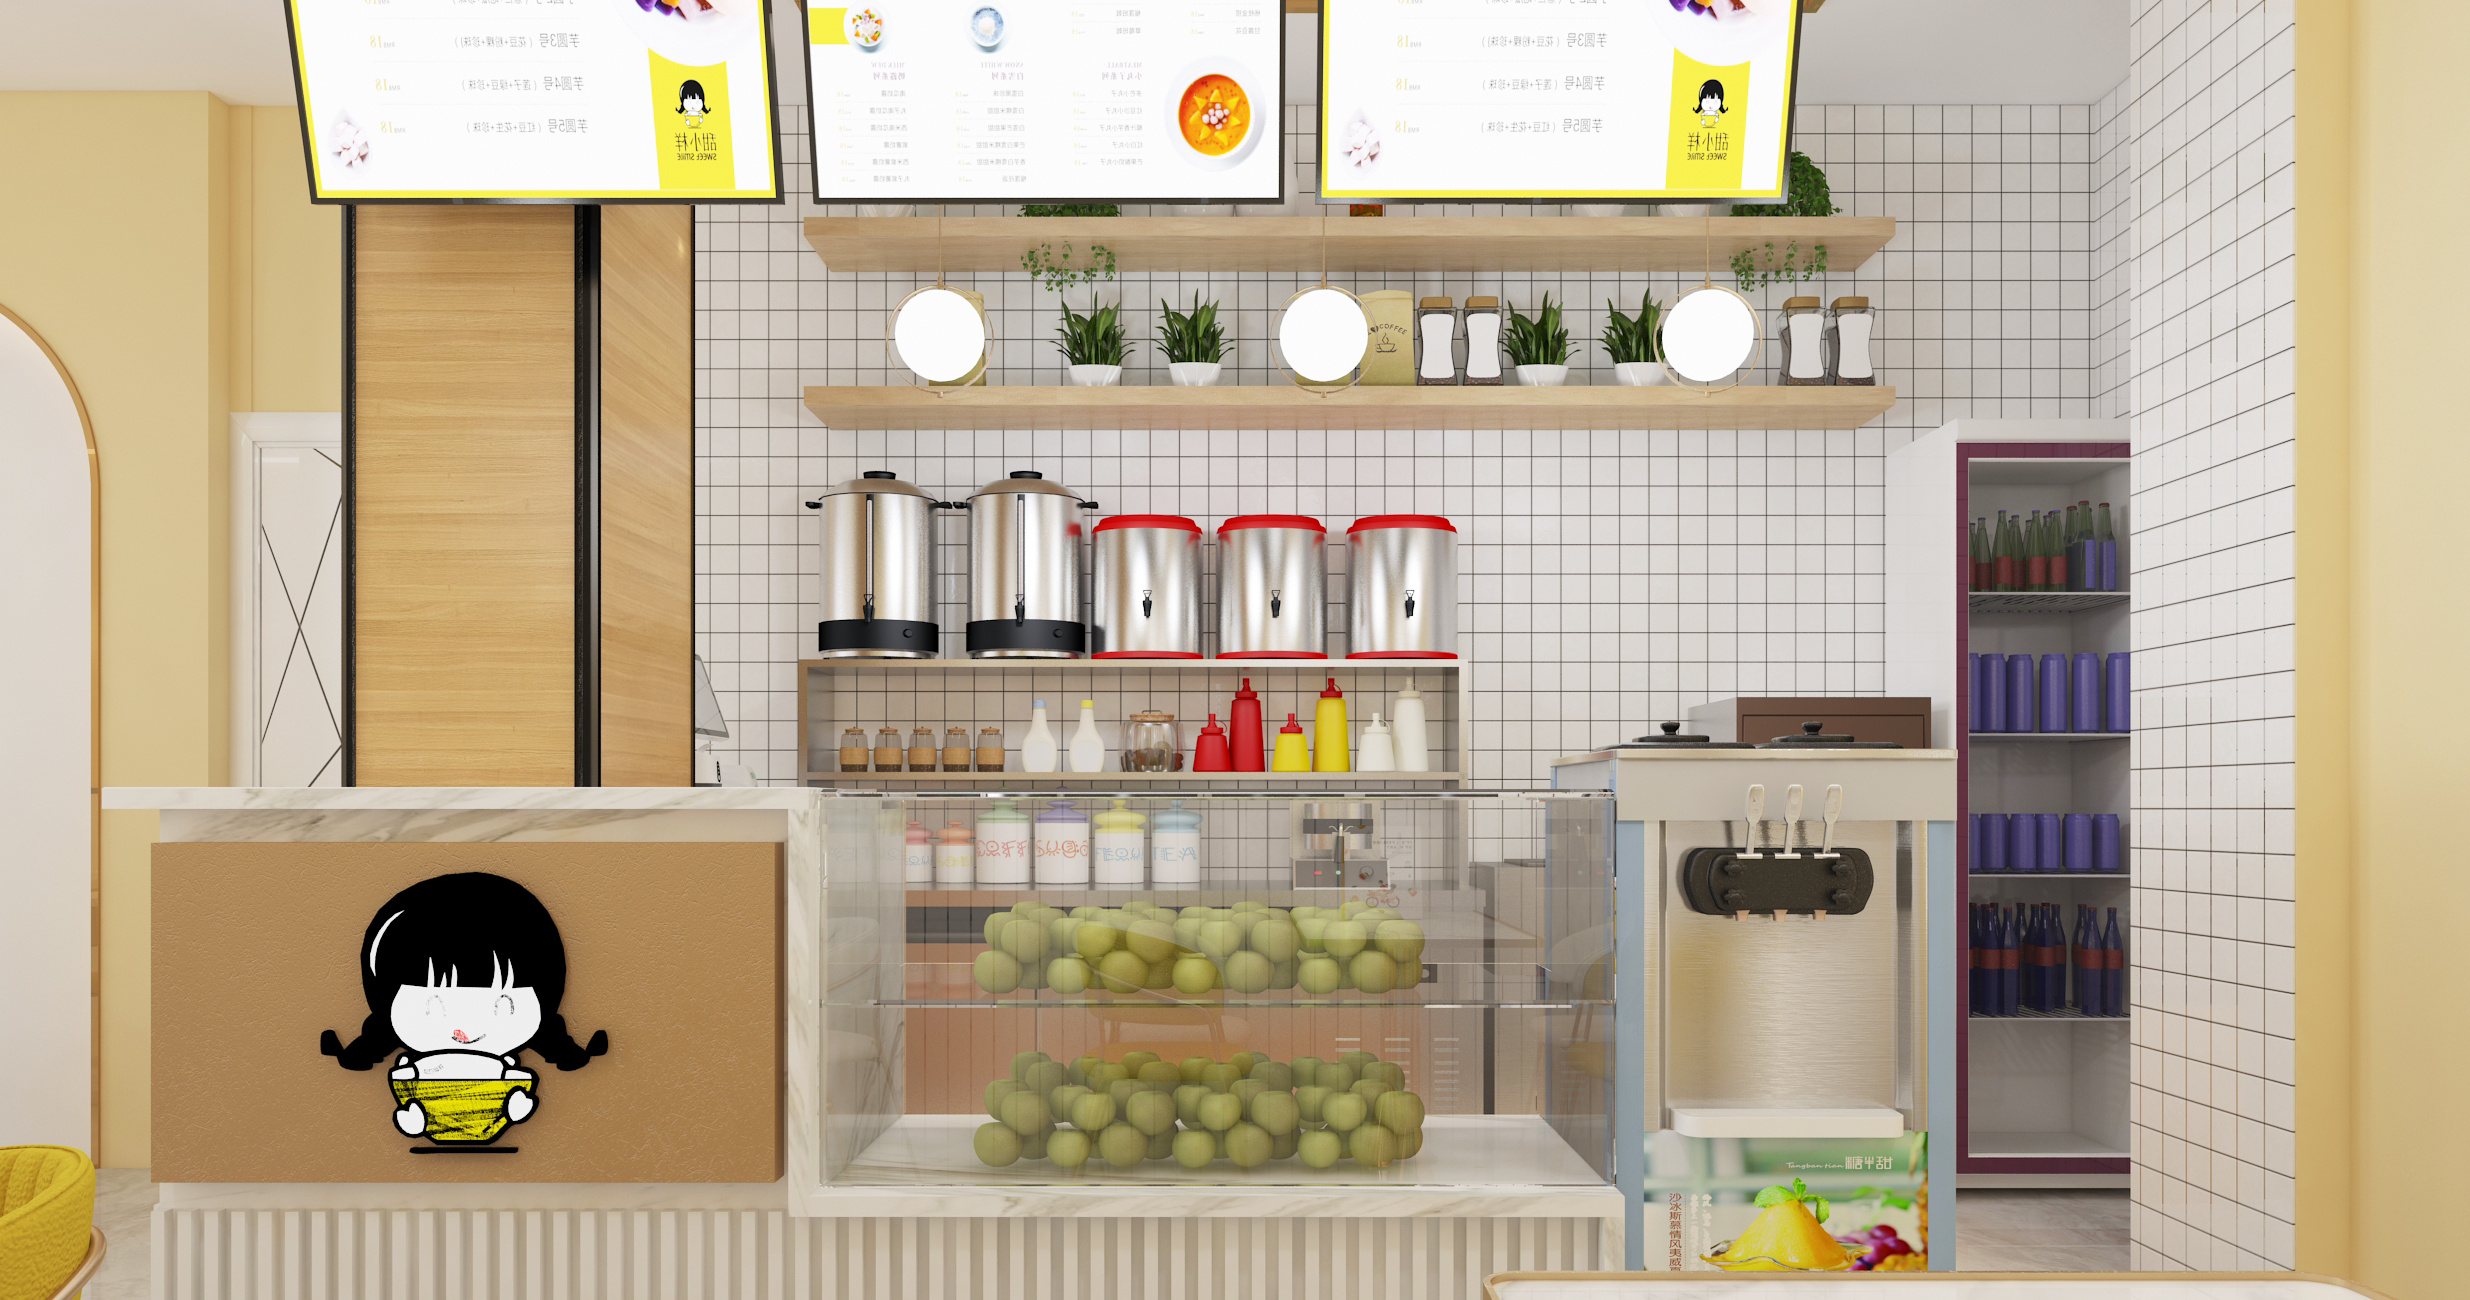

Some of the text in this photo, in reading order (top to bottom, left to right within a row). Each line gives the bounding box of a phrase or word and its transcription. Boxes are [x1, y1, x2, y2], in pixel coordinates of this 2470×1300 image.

[1379, 323, 1408, 335] COFFEE
[1153, 847, 1198, 862] TEA
[1845, 1156, 1893, 1170] 糖半甜
